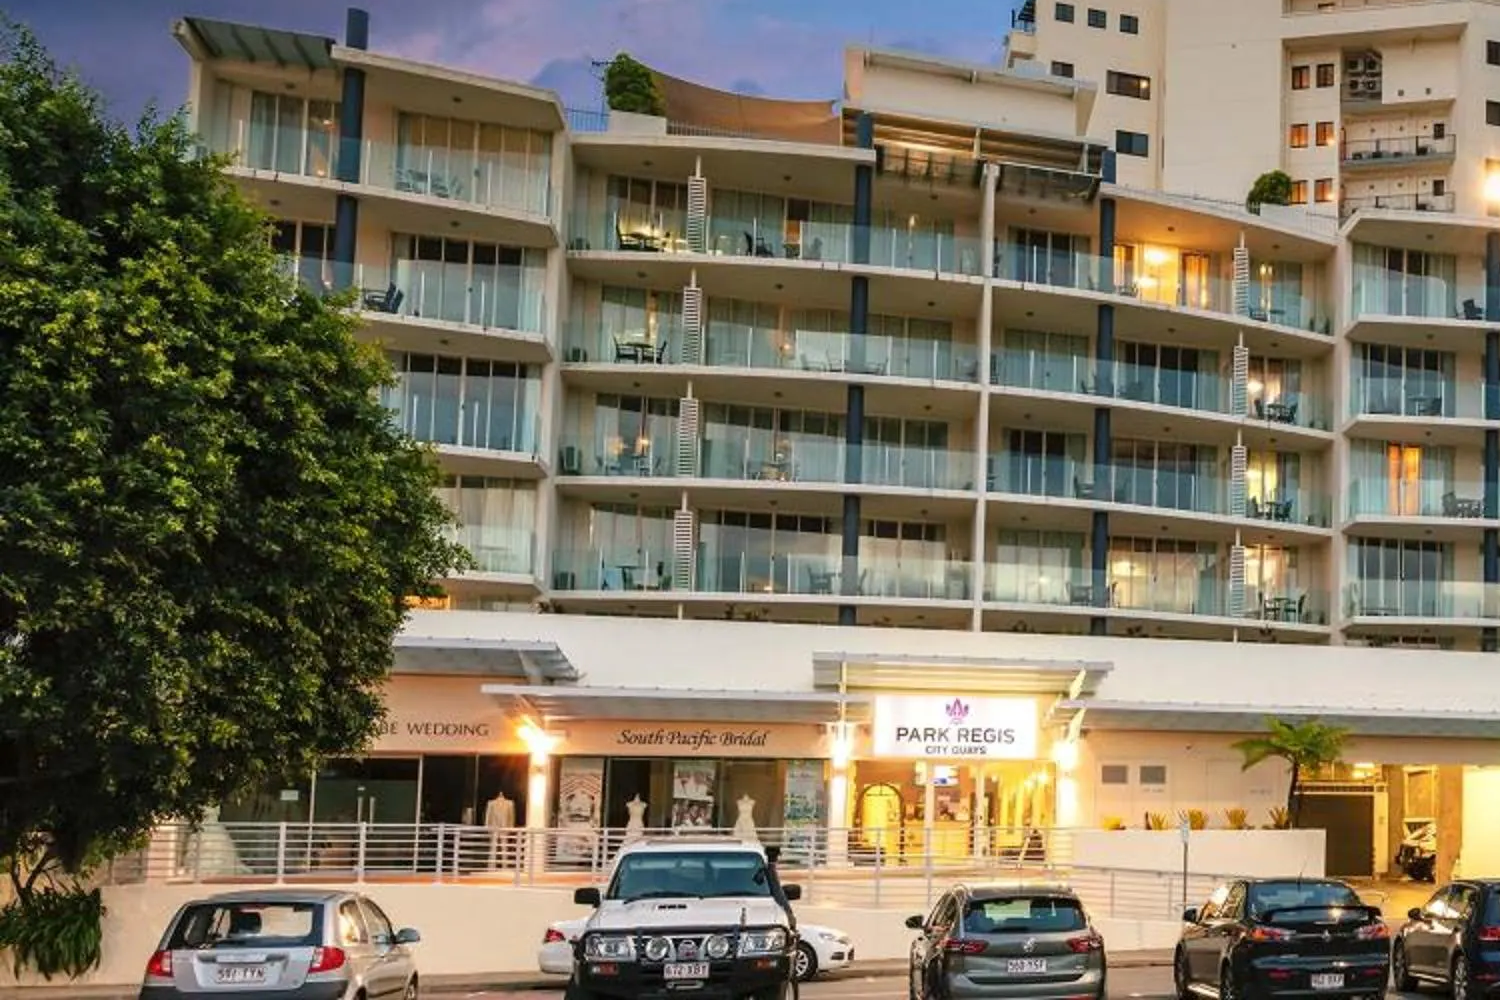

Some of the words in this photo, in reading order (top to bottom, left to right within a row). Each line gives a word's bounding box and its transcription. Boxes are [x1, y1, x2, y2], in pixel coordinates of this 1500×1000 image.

[407, 722, 489, 737] WEDDING
[896, 727, 950, 743] PARK
[957, 727, 1015, 744] REGIS
[617, 729, 664, 745] South
[665, 729, 718, 750] Pacific
[720, 730, 771, 747] Bridal
[925, 745, 948, 755] CITY
[951, 745, 987, 755] QUAYS
